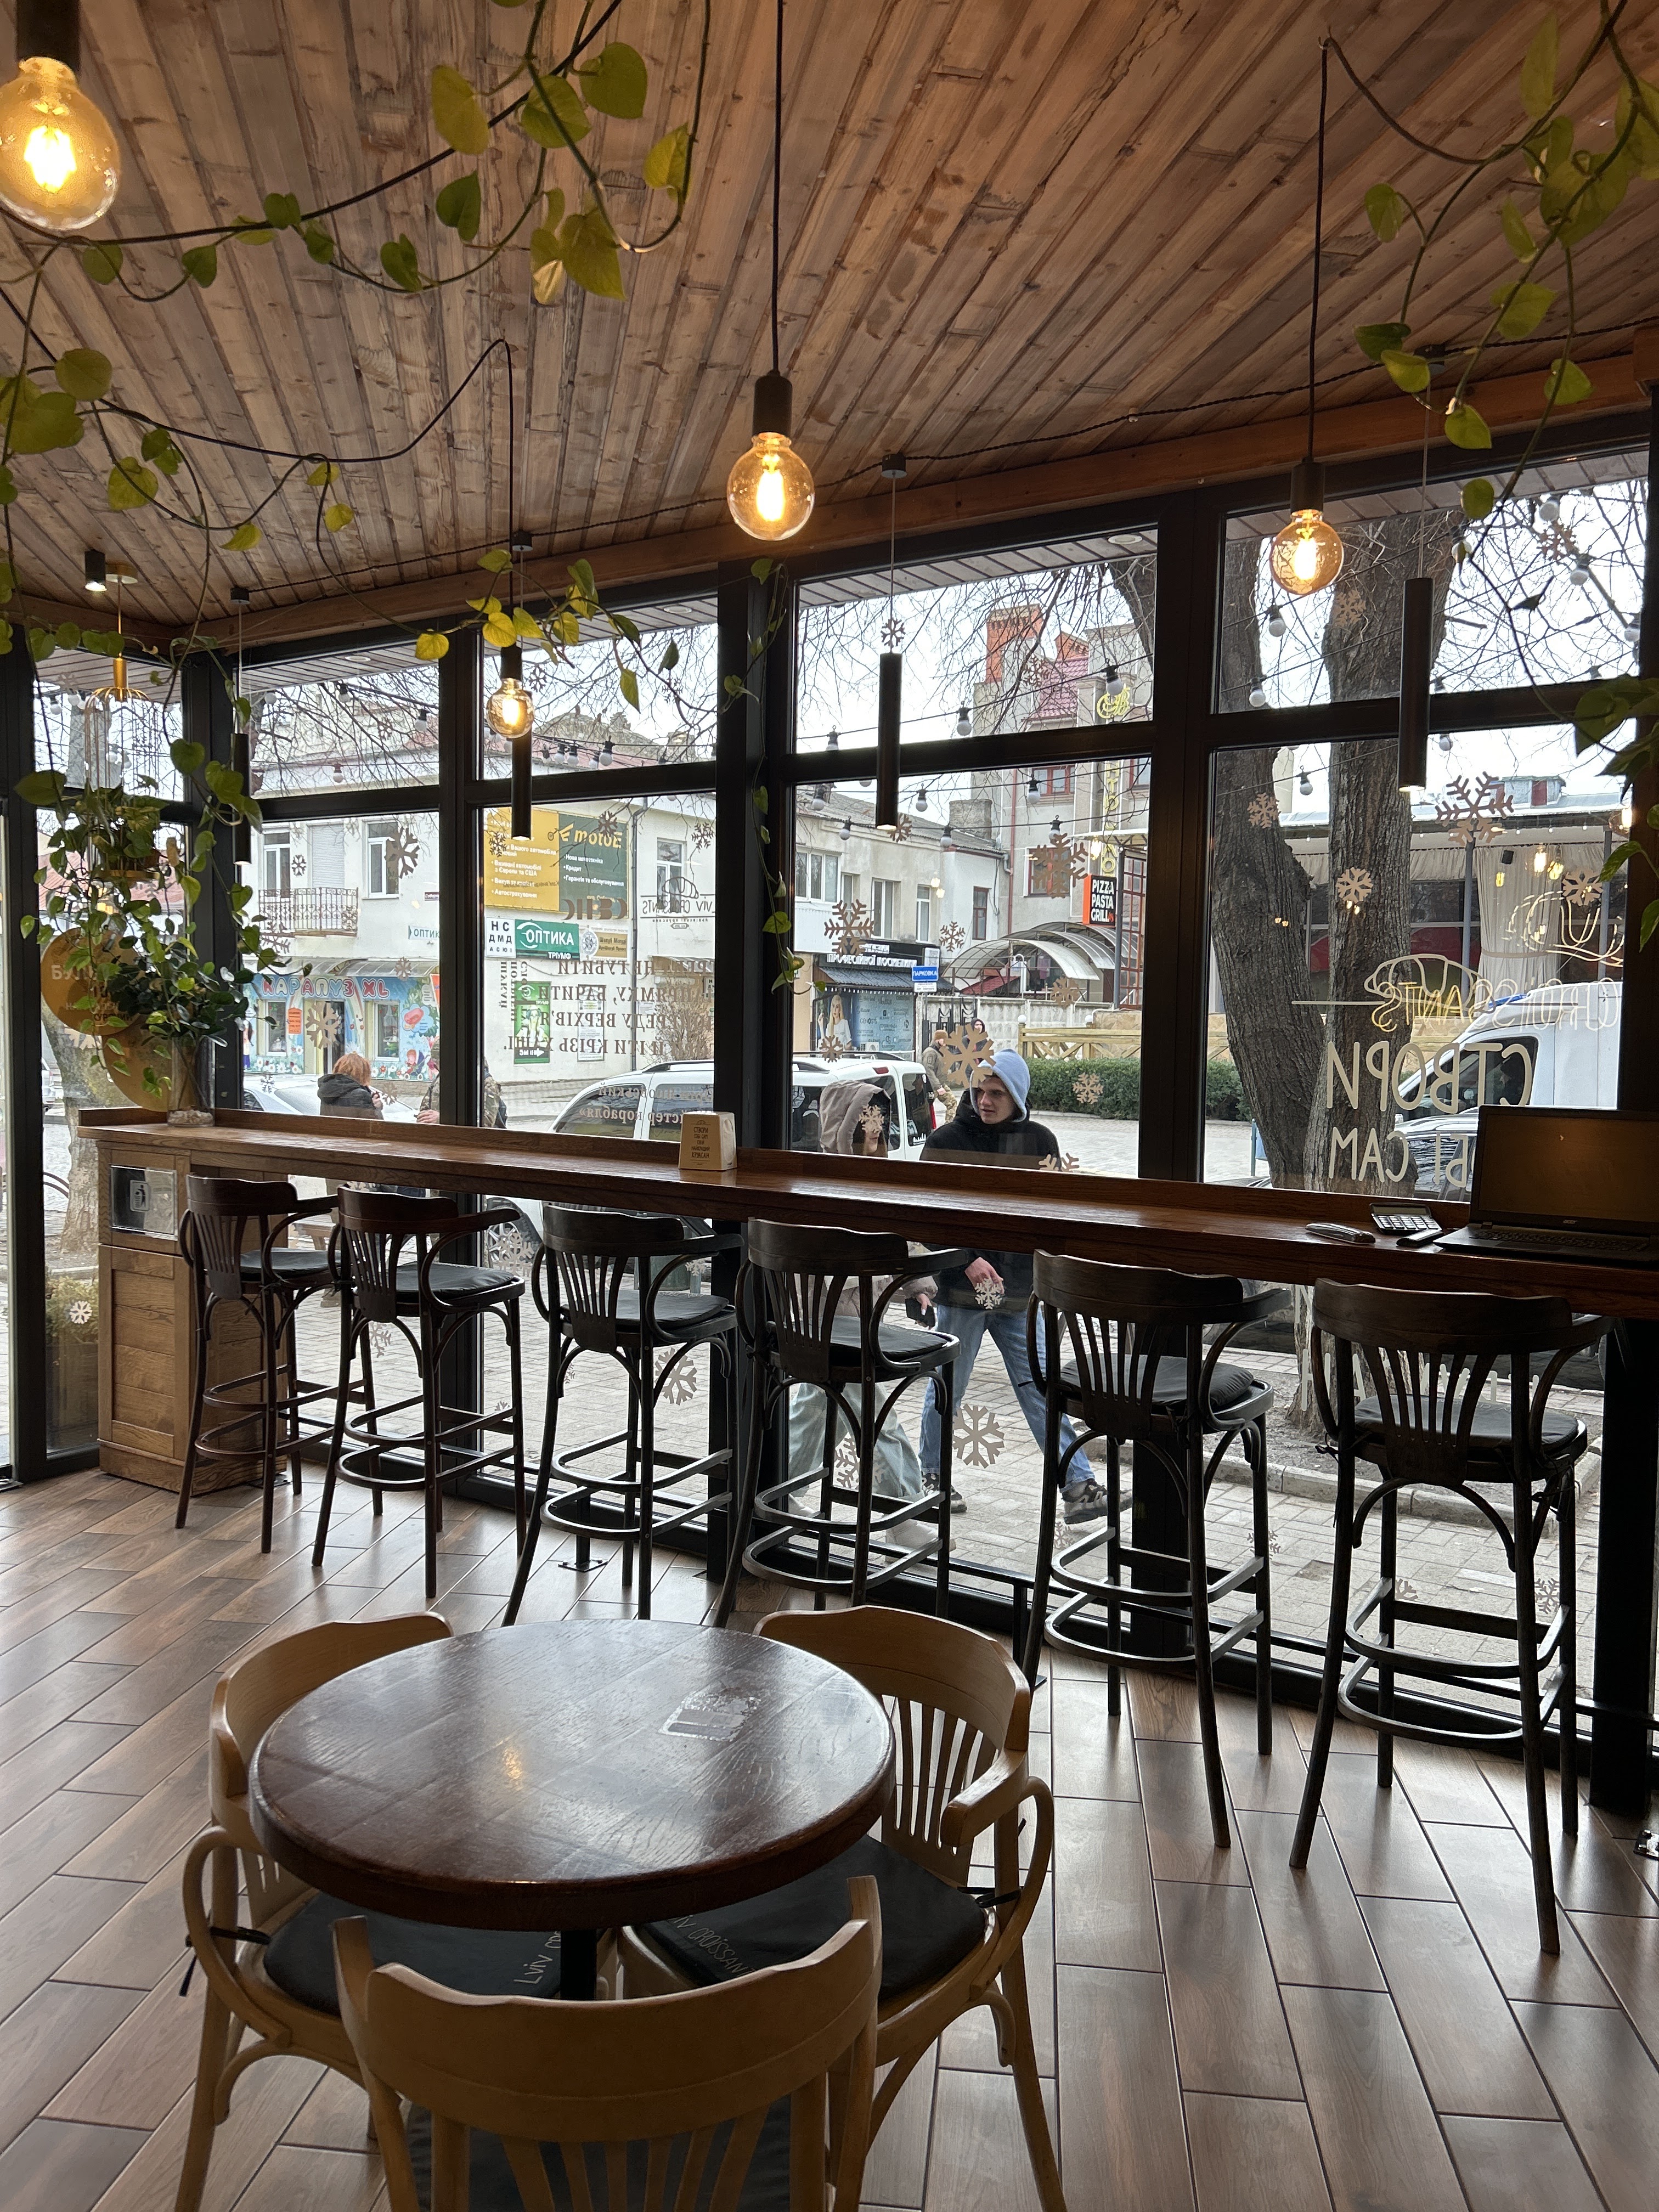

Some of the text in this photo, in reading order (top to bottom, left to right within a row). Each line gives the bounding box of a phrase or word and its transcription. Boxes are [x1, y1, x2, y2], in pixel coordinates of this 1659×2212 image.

[574, 829, 623, 849] motoE
[1092, 879, 1114, 895] PIZZA
[1091, 894, 1114, 910] PASTA
[1091, 908, 1110, 922] GRILL
[526, 929, 574, 946] ОПТИКА
[548, 951, 572, 960] ТРІУМФ
[827, 953, 877, 966] ПРОФЕСІЙНОЇ
[877, 957, 917, 968] КОСМЕТИКИ
[263, 977, 390, 998] КАРАПУЗ XL
